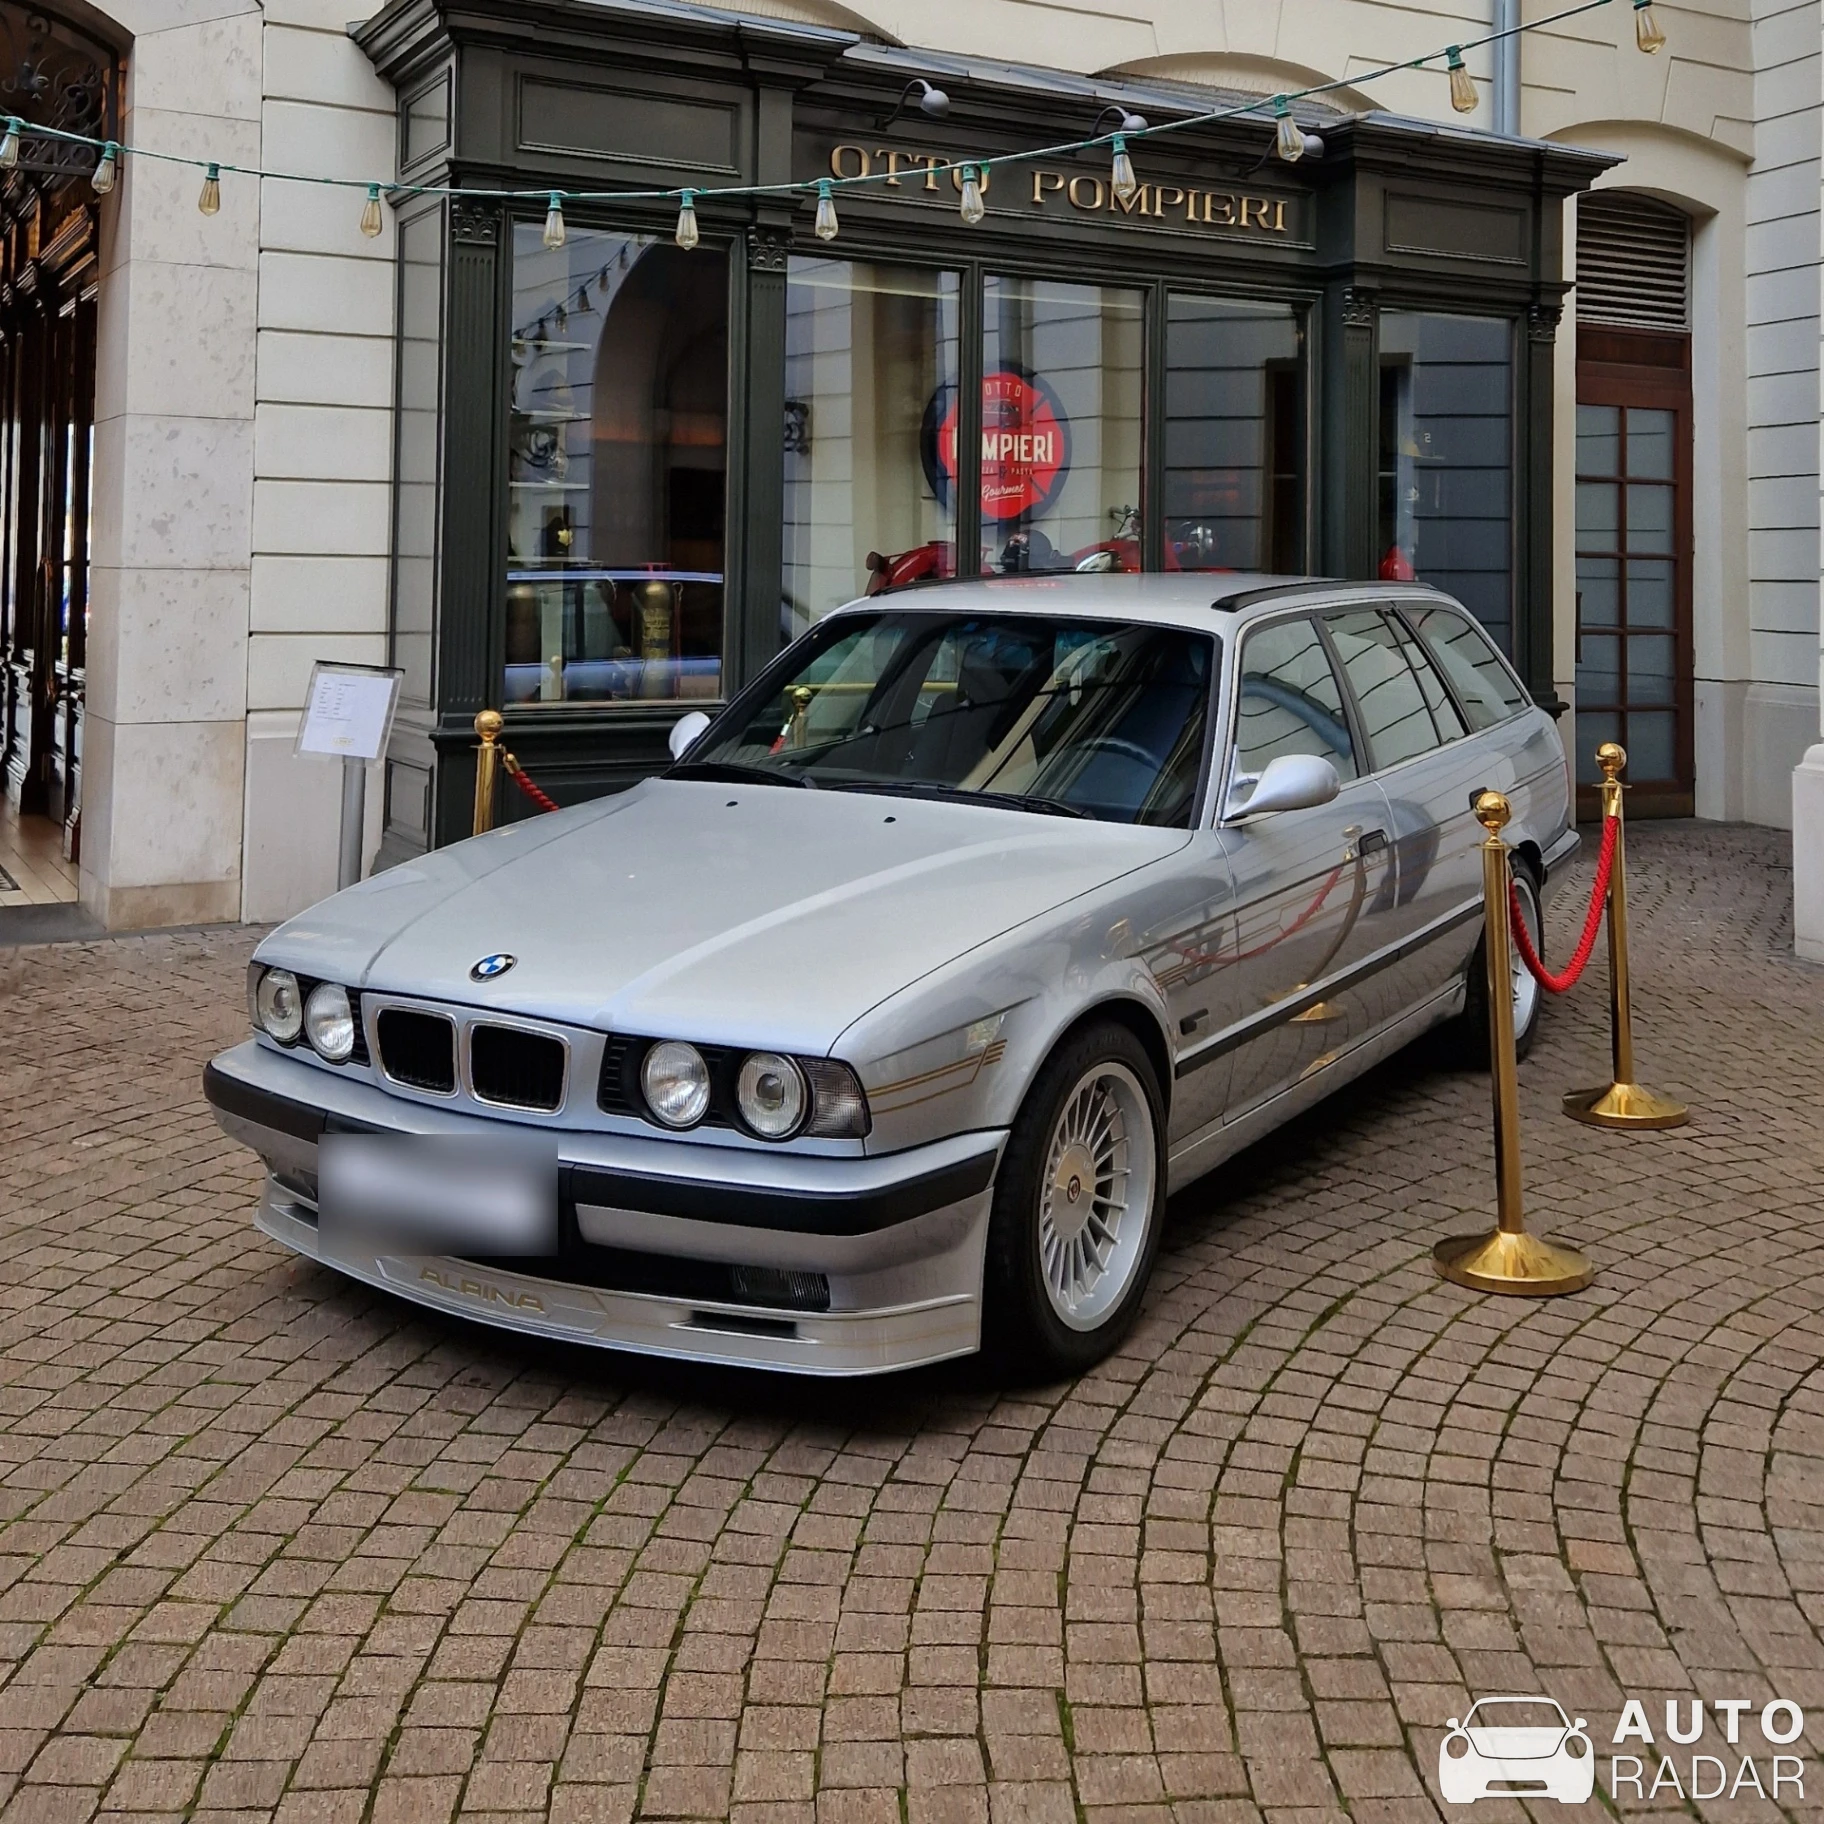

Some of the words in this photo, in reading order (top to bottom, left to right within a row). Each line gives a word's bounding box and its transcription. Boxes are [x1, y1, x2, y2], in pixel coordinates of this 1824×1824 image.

[1030, 169, 1288, 233] POMPIERI
[984, 382, 1022, 397] OTTO
[952, 426, 1054, 465] MPIERI
[1010, 467, 1033, 475] PASTA
[981, 483, 1025, 502] Gourmet
[418, 1266, 546, 1314] ALPINA
